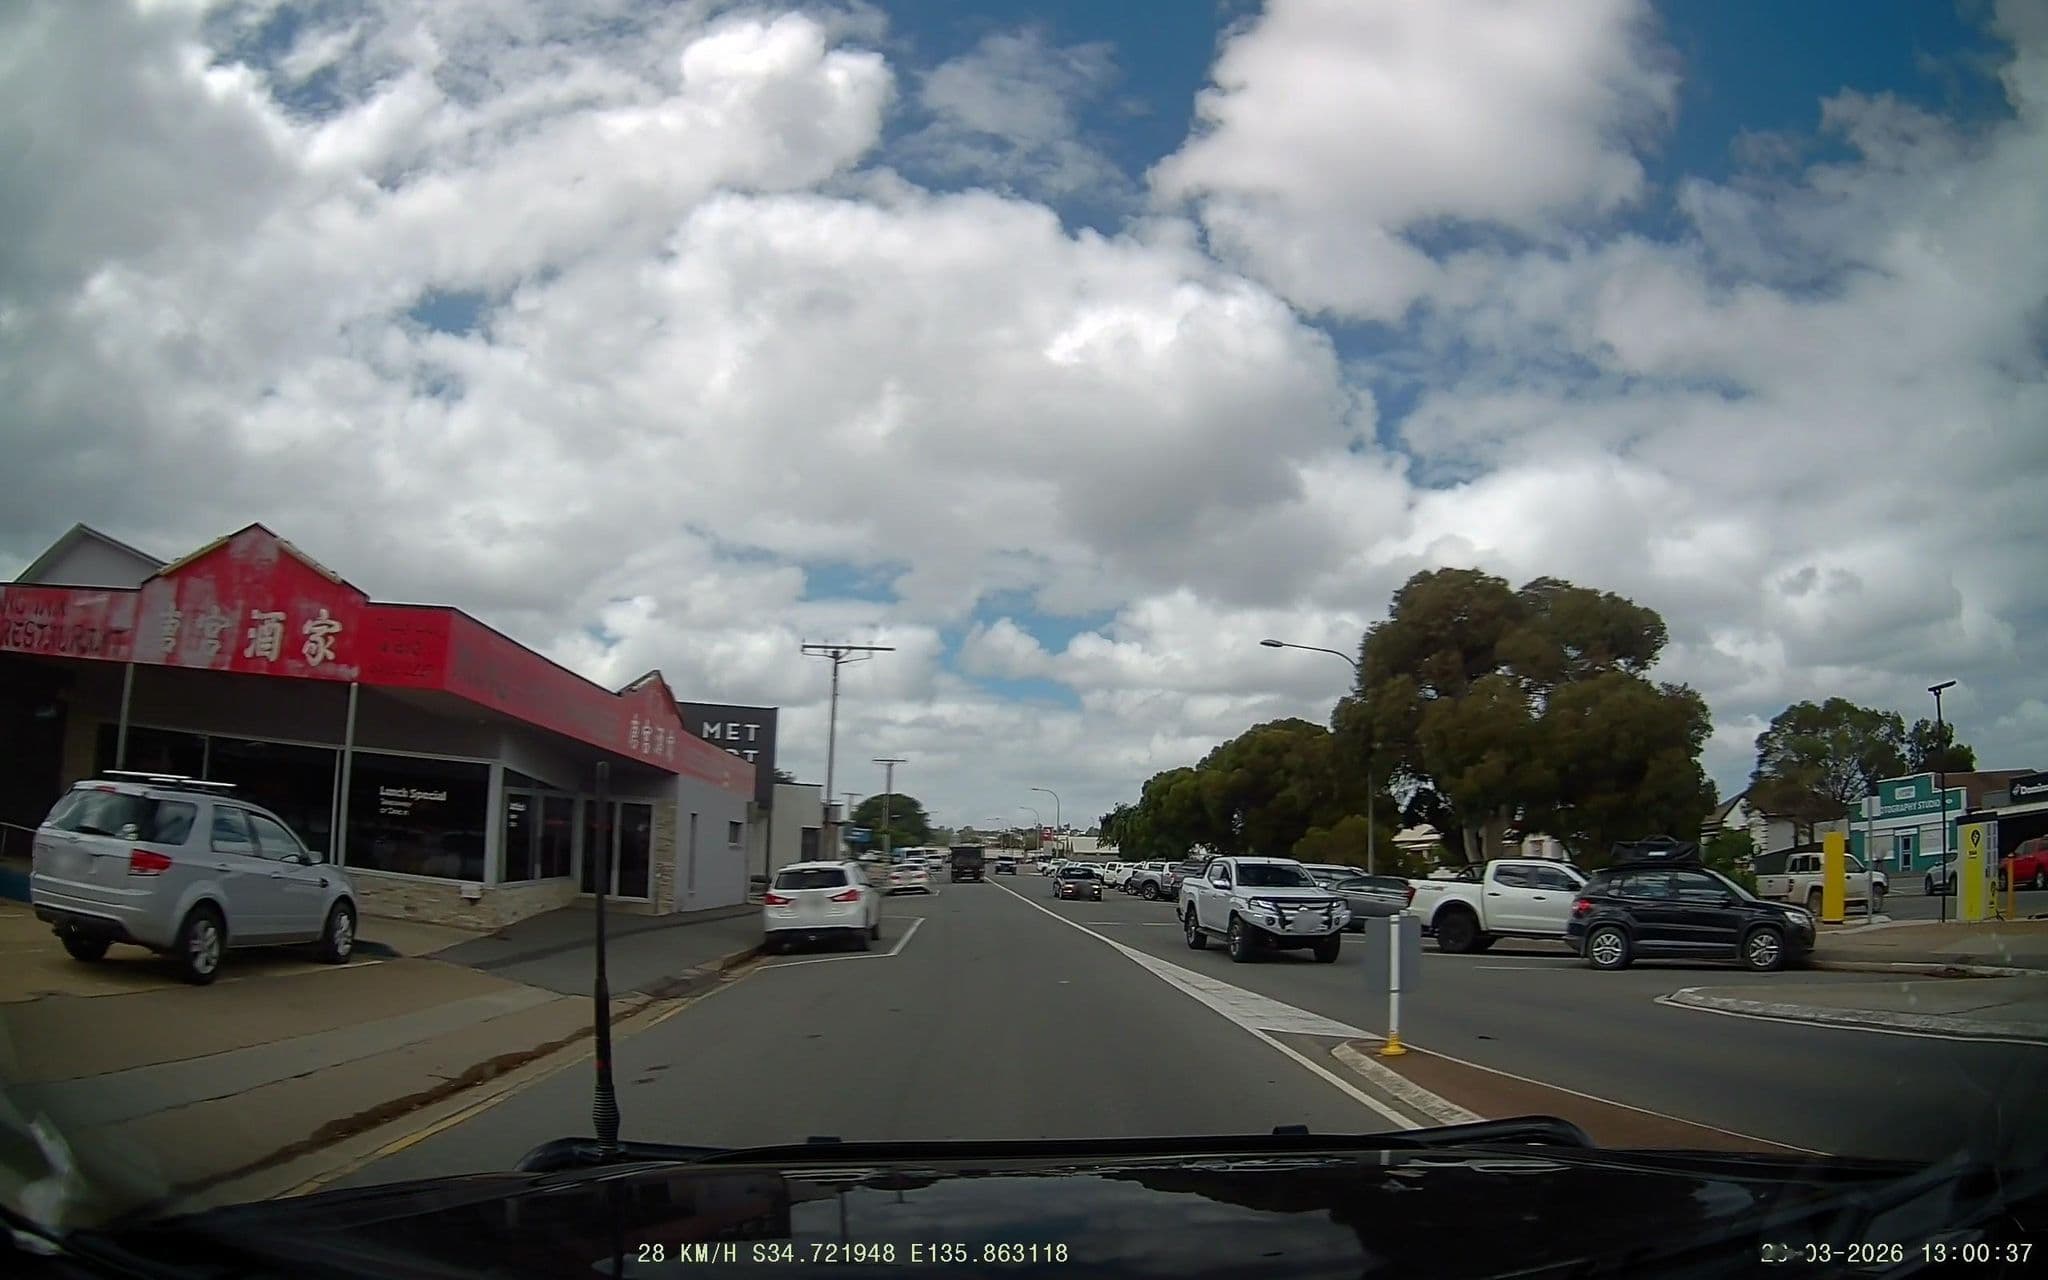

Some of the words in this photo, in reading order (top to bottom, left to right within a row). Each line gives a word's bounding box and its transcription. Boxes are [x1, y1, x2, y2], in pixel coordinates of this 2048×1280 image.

[702, 721, 761, 742] MET
[1880, 802, 1917, 815] OTOGRAPHY
[1918, 799, 1941, 810] STUDIO
